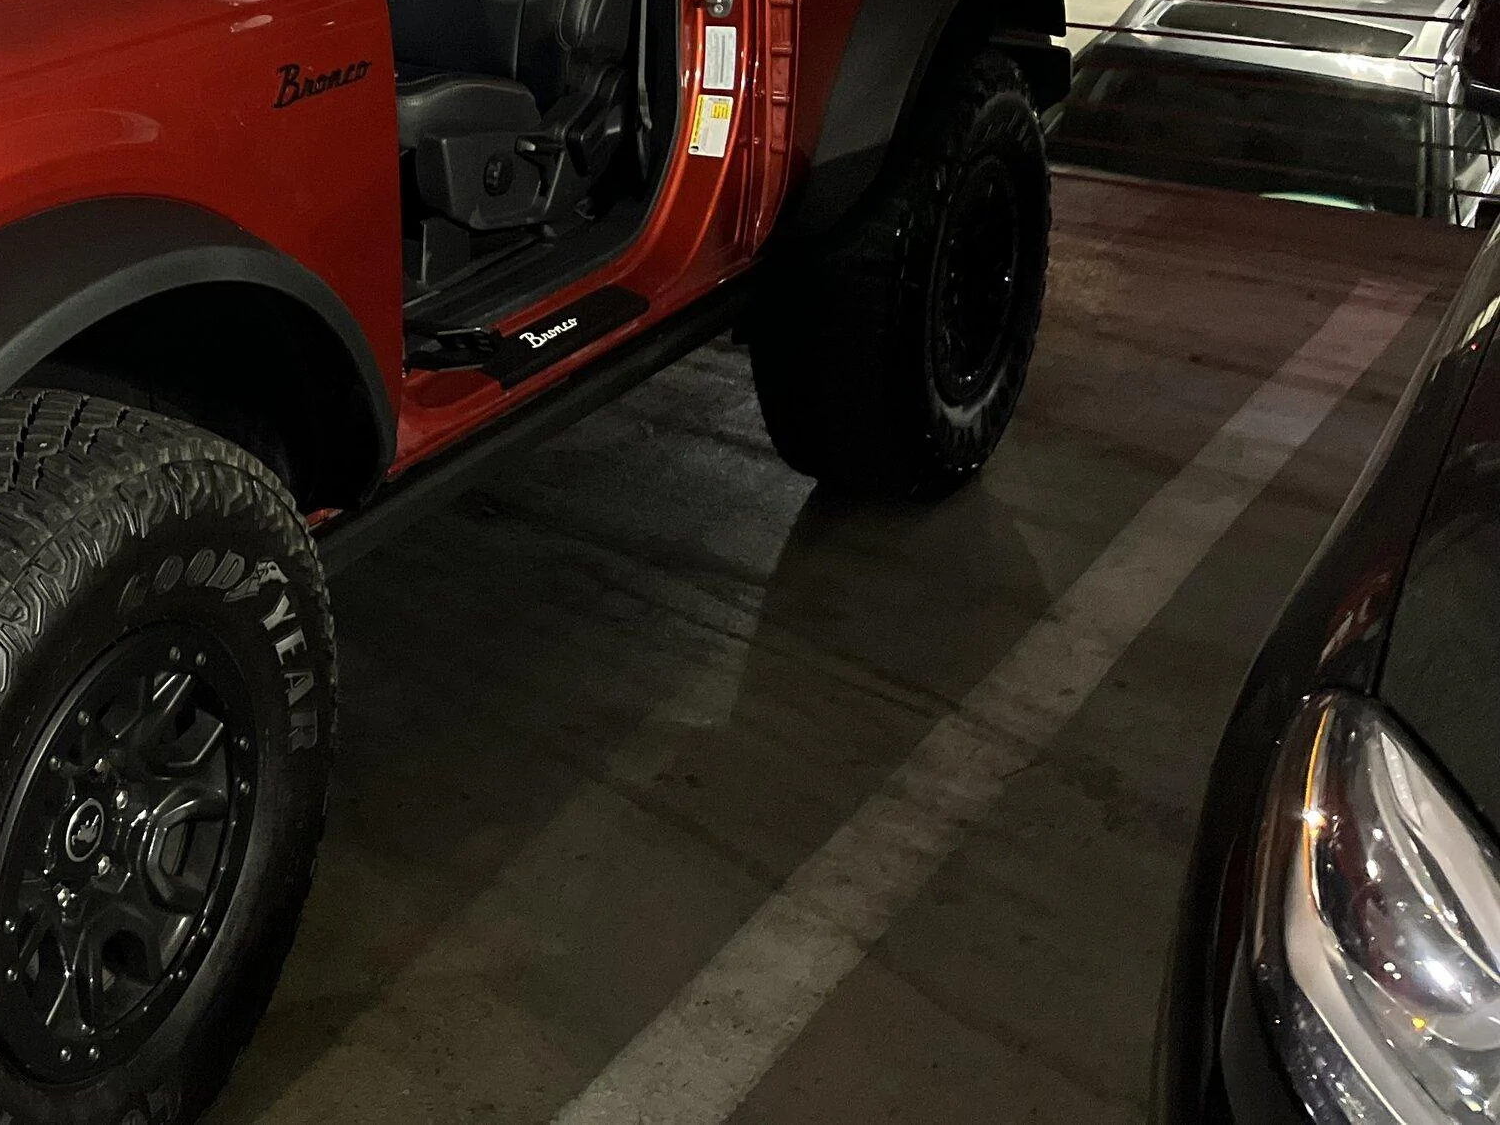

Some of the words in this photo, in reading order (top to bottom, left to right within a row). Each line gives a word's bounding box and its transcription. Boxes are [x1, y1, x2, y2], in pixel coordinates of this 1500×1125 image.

[272, 60, 372, 108] Bronco
[519, 317, 578, 349] Bronco
[118, 548, 319, 754] GOODYEAR
